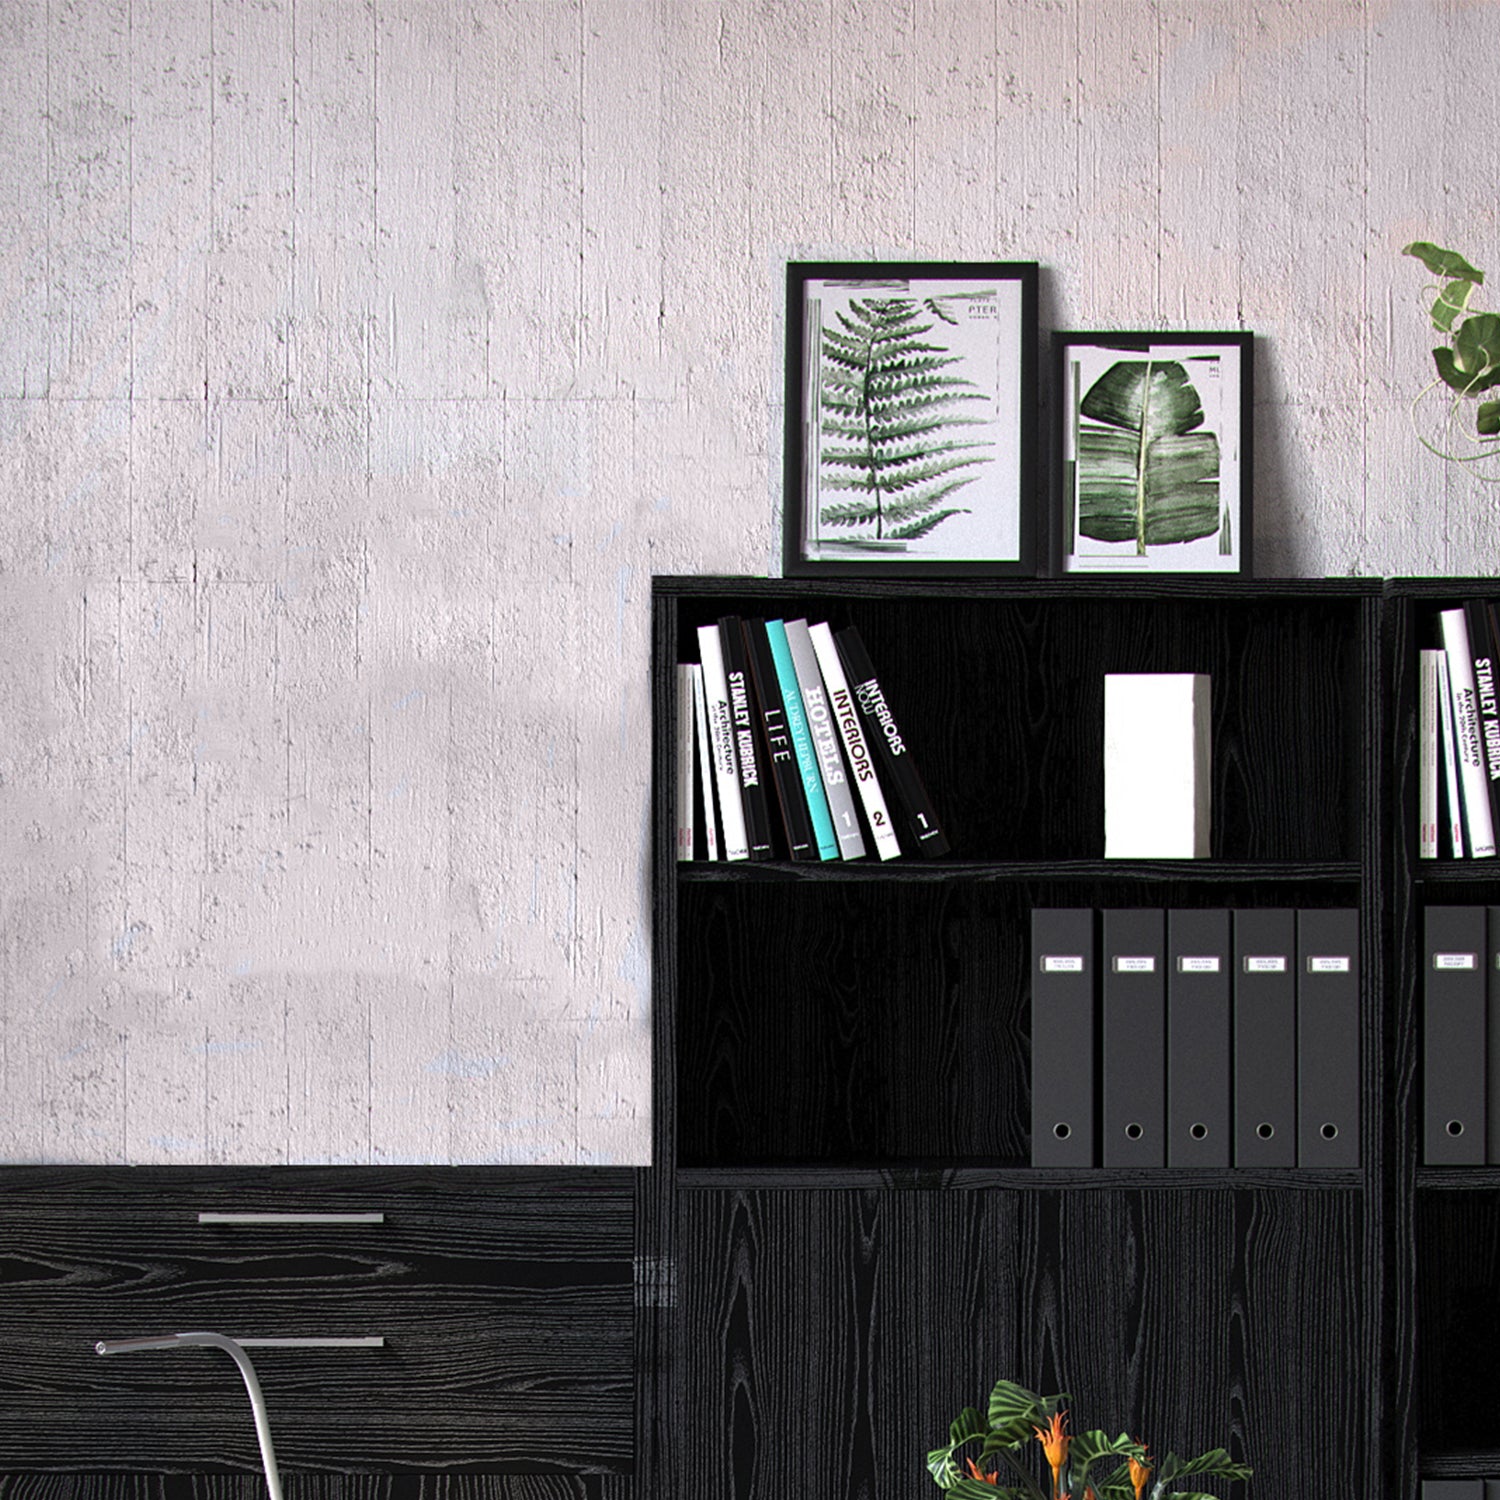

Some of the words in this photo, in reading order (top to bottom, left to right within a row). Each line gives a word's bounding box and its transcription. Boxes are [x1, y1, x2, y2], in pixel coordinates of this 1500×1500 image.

[729, 671, 750, 726] STANLEY
[855, 685, 876, 716] NOW
[1475, 657, 1498, 716] STANLEY
[717, 700, 734, 775] Architecture
[764, 709, 791, 763] LIFE
[805, 686, 844, 786] HOTELS
[833, 689, 873, 782] INTERIORS
[864, 679, 906, 757] INTERIORS
[1463, 688, 1480, 767] Architecture
[737, 729, 758, 788] KUBRICK
[842, 811, 852, 828] 1
[873, 811, 886, 827] 2
[917, 812, 929, 829] 1
